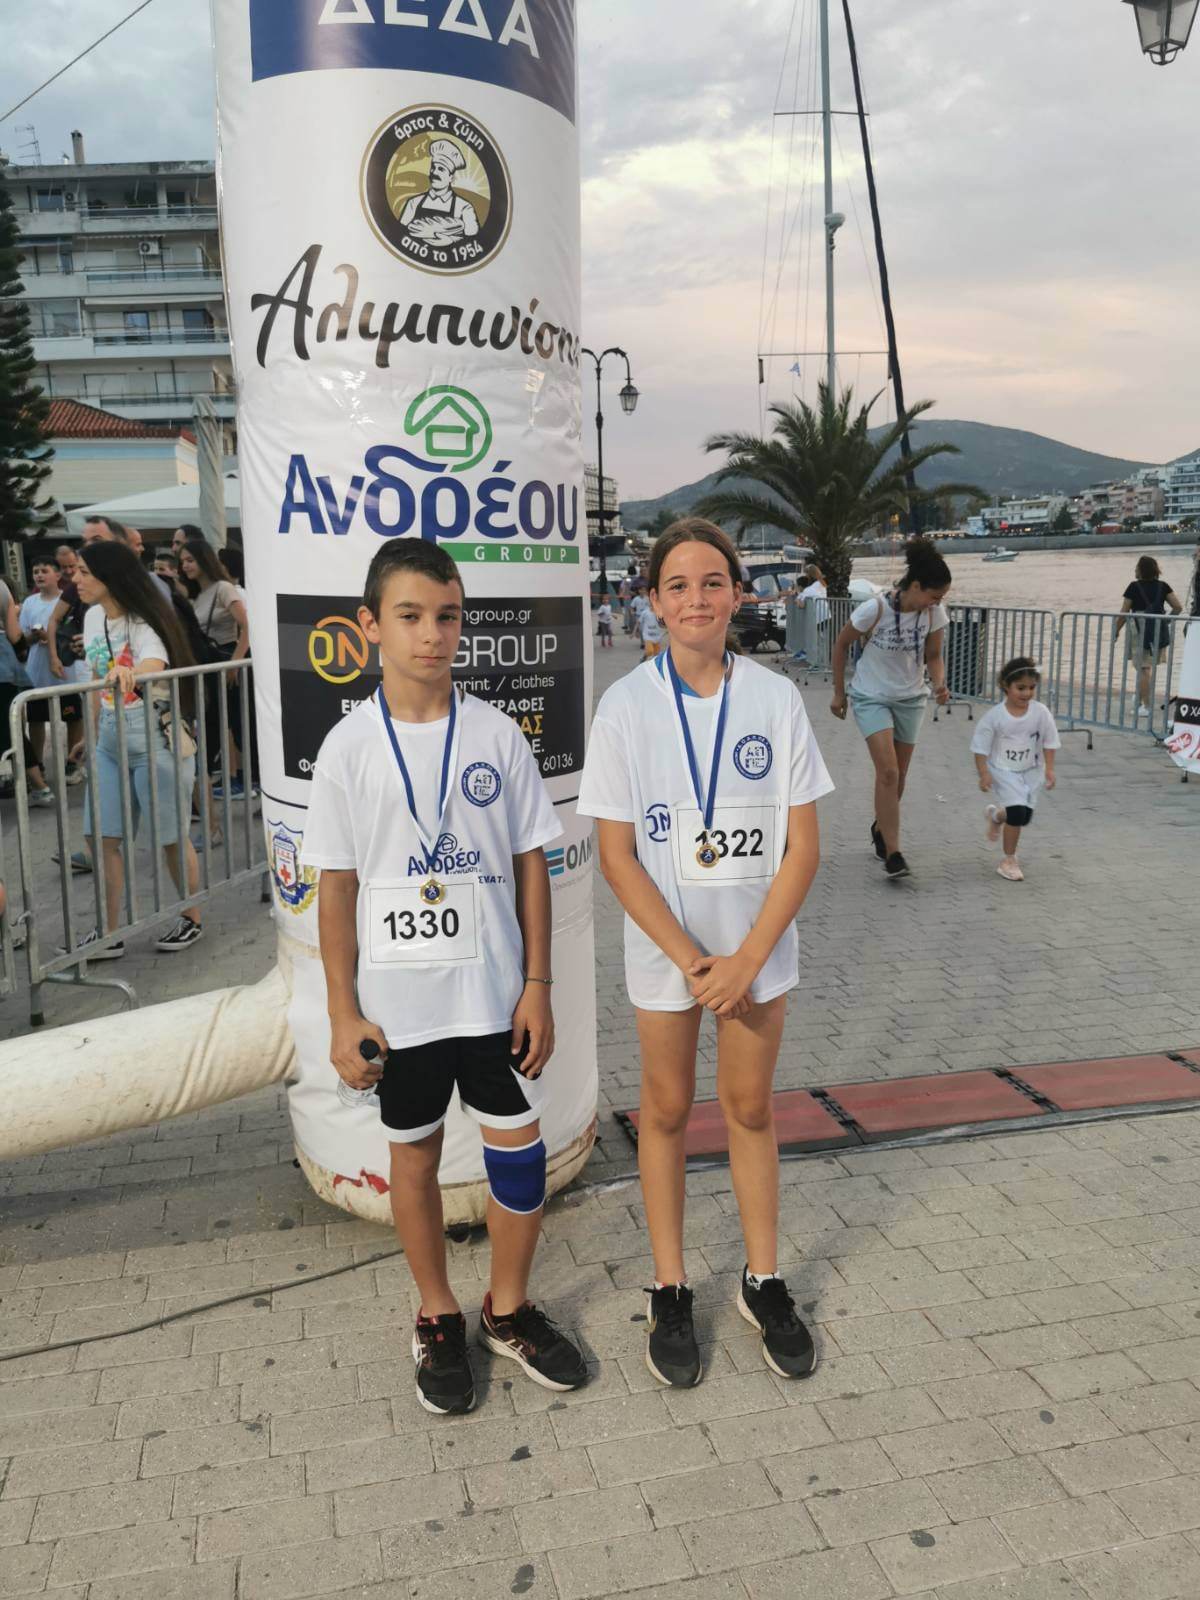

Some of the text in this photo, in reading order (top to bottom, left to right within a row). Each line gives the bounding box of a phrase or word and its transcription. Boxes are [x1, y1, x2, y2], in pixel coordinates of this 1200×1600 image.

[394, 113, 485, 151] άρτος & ζύμη
[401, 236, 484, 263] από το 1954
[278, 444, 577, 545] Ανδρέου
[474, 545, 567, 563] GROUP
[451, 633, 557, 668] GROUP
[511, 674, 555, 690] clothes
[542, 752, 574, 772] 60136
[695, 828, 764, 859] 1322
[383, 907, 459, 941] 1330
